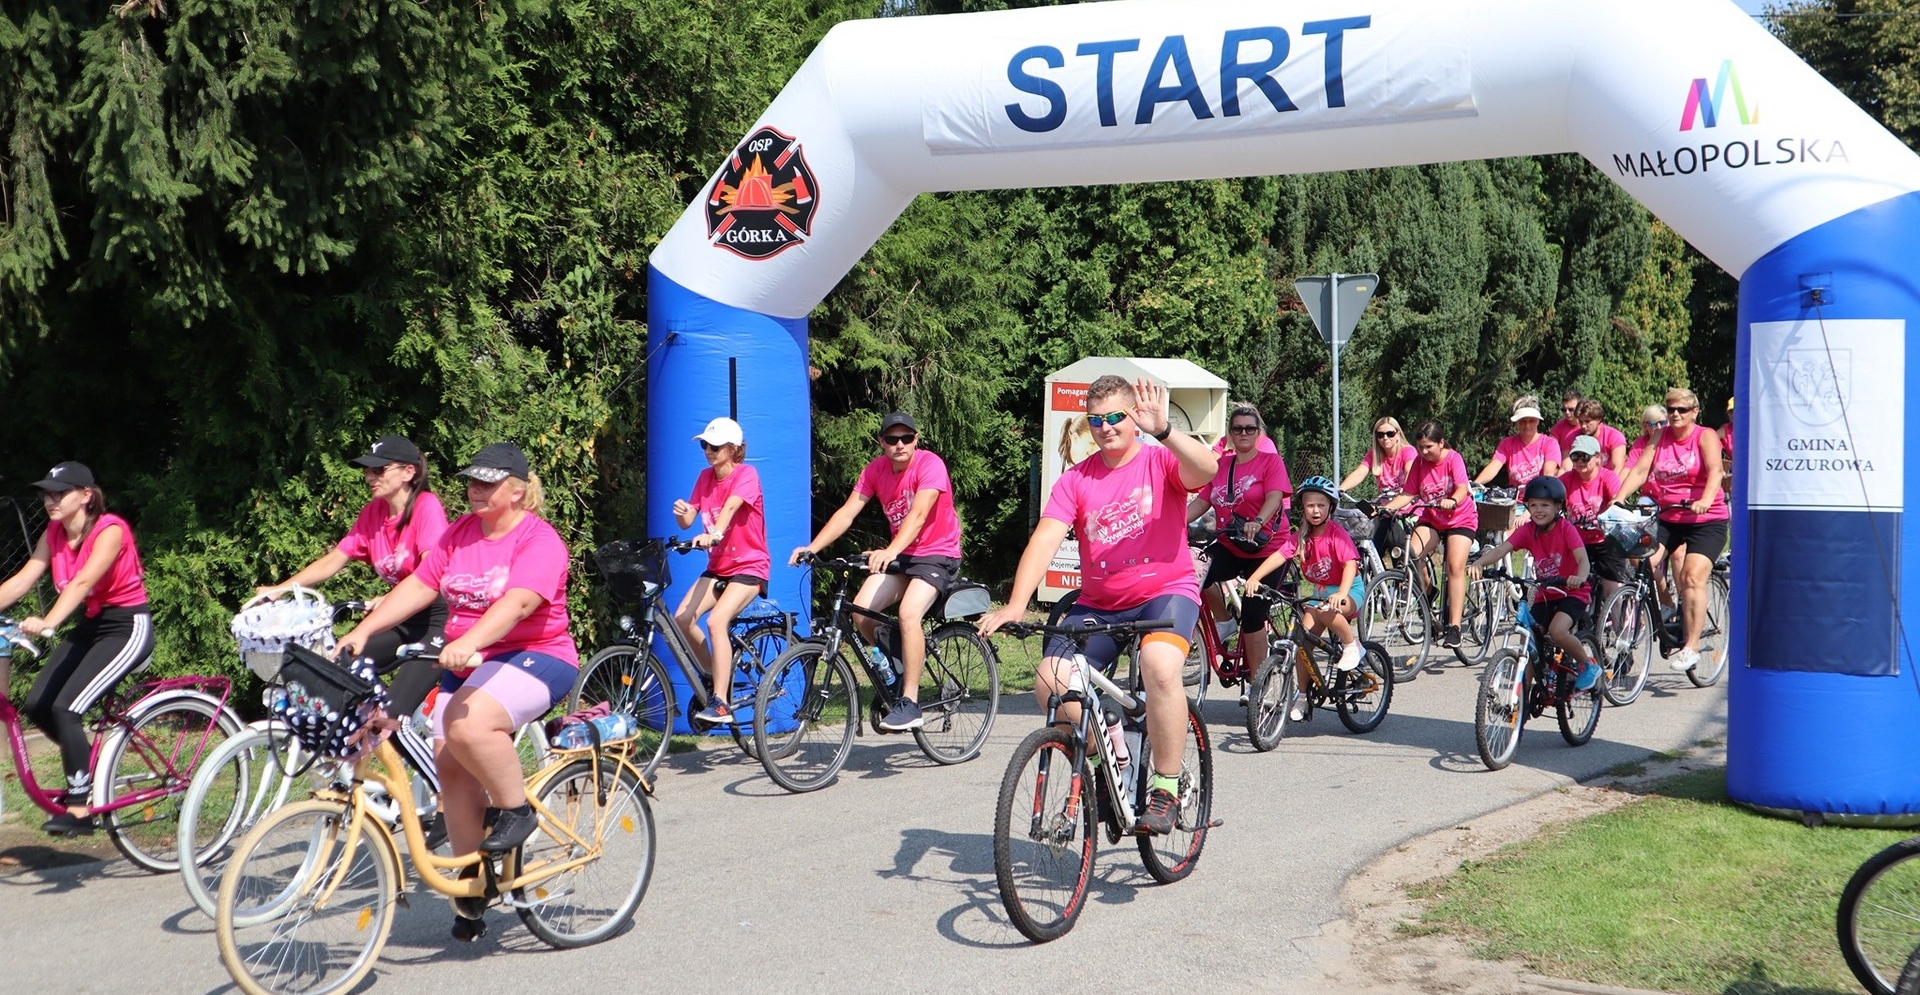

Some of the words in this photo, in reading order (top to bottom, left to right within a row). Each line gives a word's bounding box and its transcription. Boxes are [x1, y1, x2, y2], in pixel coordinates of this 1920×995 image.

[1004, 15, 1371, 133] START
[748, 138, 773, 152] OSP
[1613, 138, 1850, 177] MAŁOPOLSKA
[726, 227, 788, 243] GÓRKA
[1788, 438, 1848, 451] GMINA
[1765, 459, 1875, 471] SZCZUROWA
[1061, 575, 1082, 587] NIE
[851, 632, 875, 669] COSSACK
